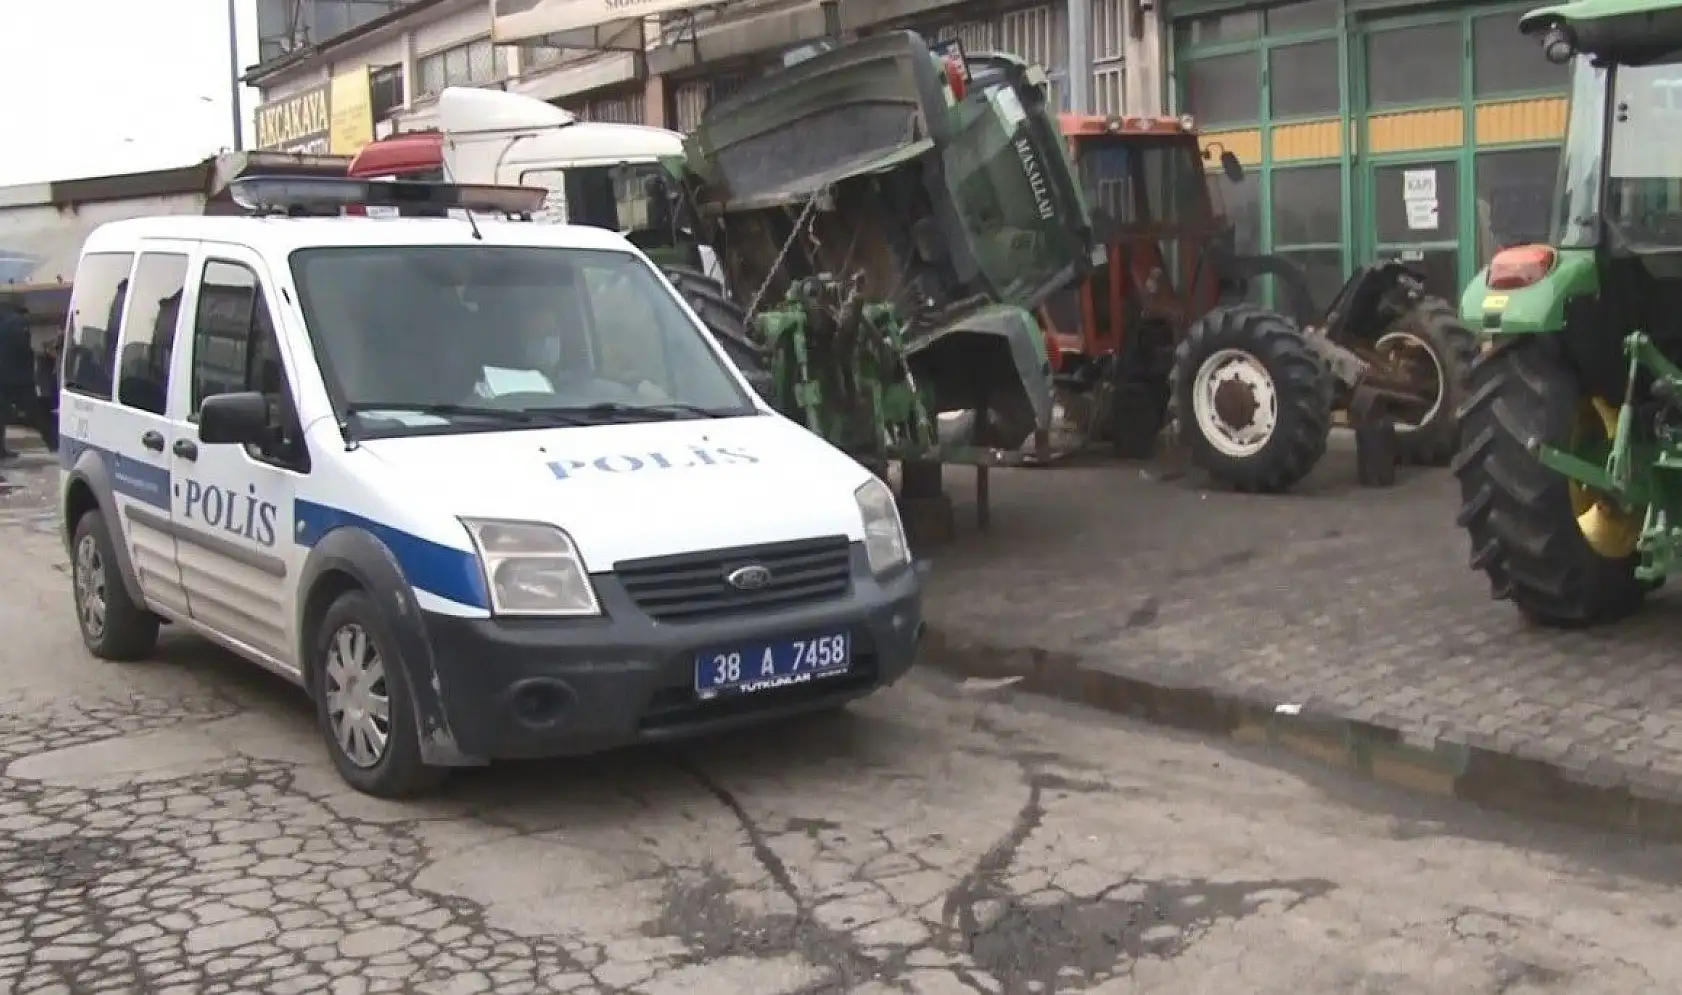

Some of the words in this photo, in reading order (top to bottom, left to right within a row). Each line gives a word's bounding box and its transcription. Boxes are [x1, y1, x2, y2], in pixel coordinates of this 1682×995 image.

[184, 478, 277, 547] POLİS
[713, 652, 741, 685] 38
[761, 646, 775, 677] A
[792, 633, 845, 671] 7458
